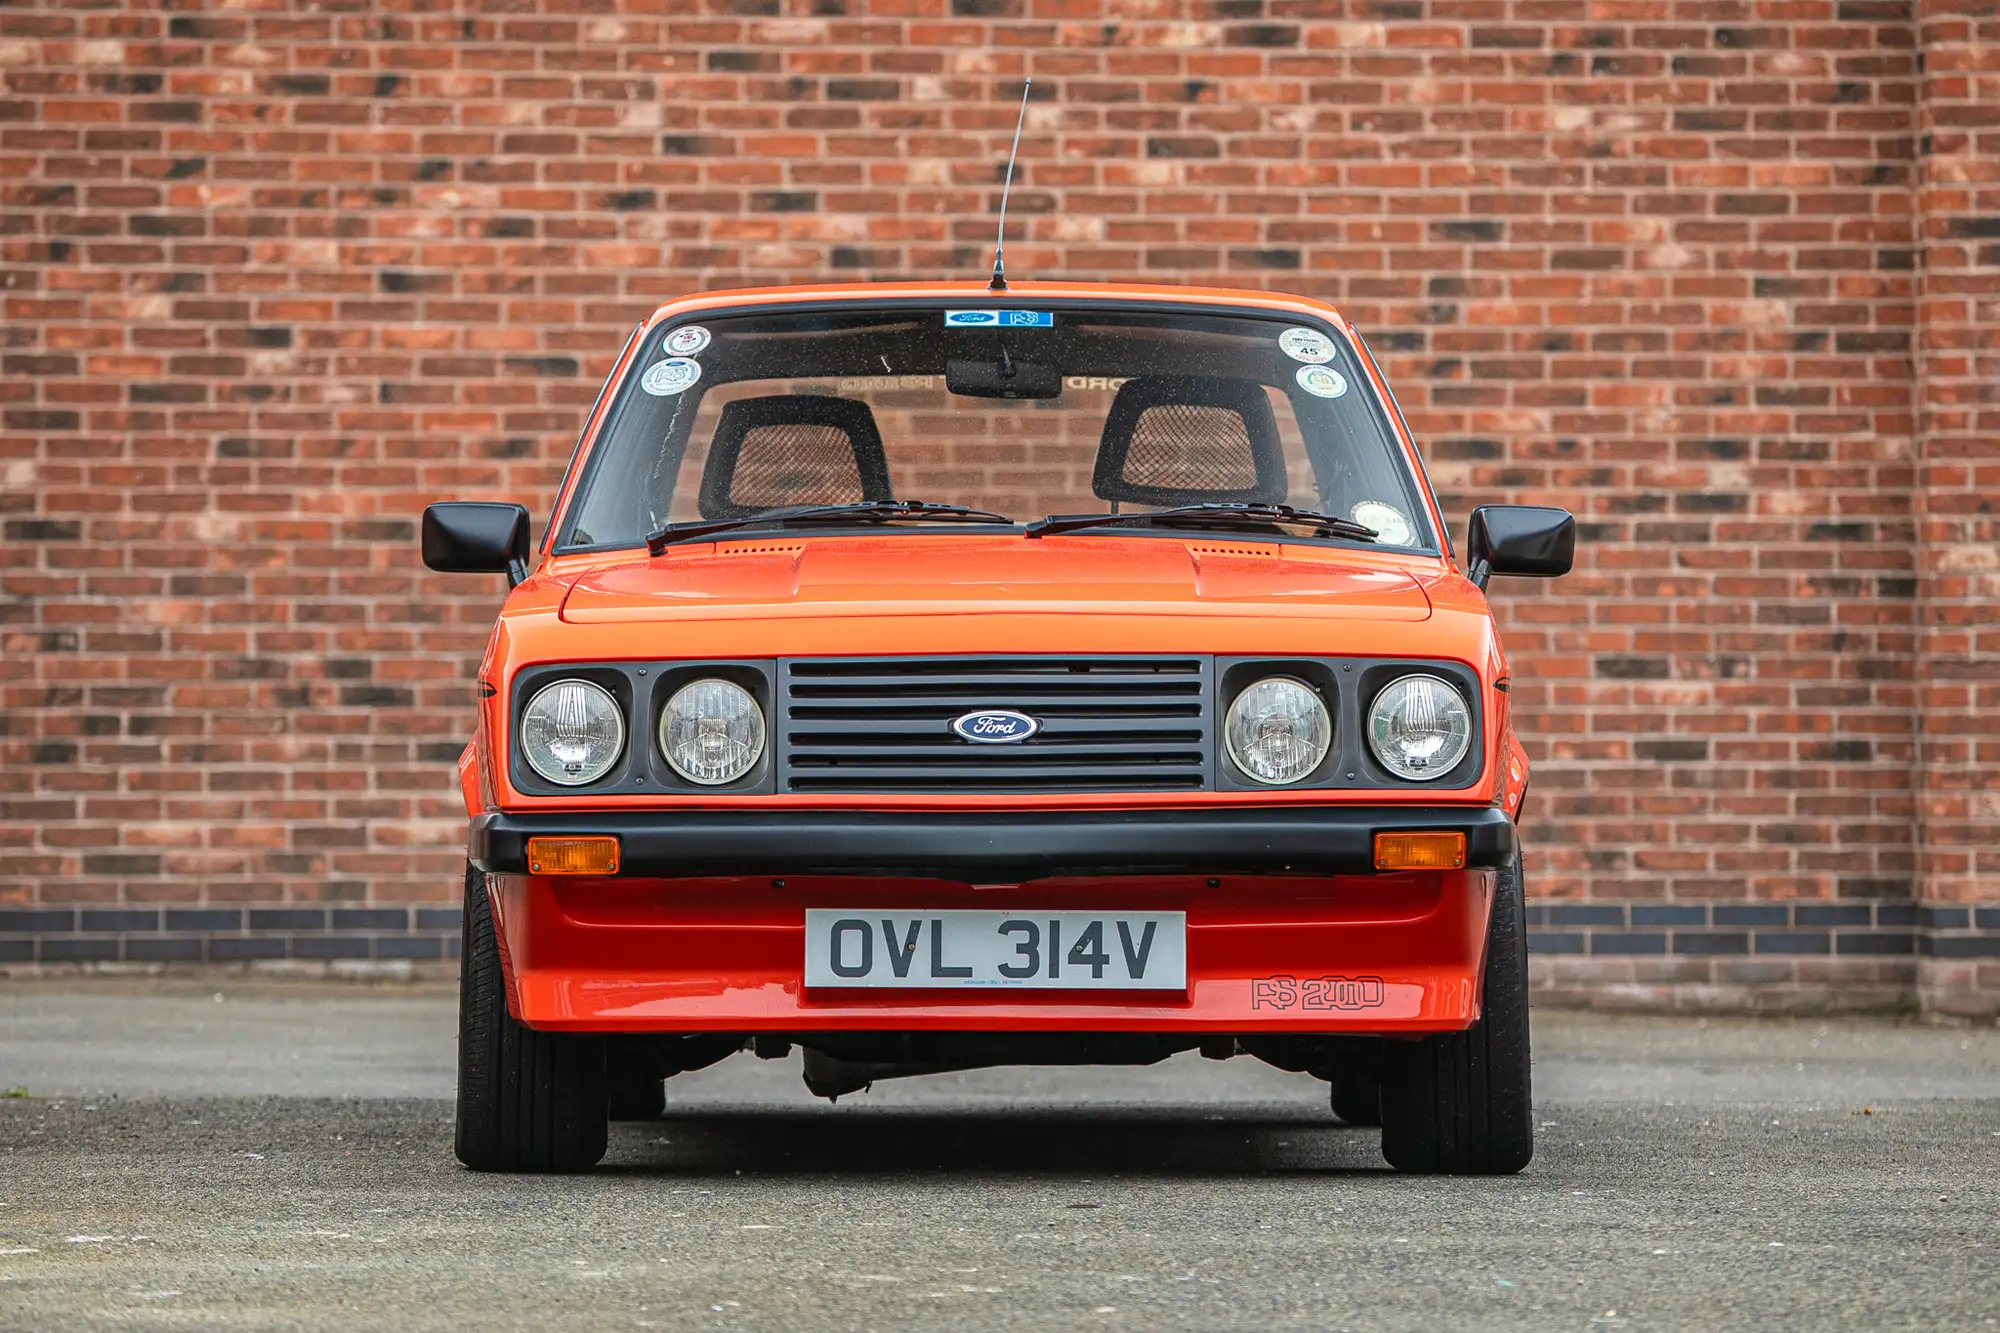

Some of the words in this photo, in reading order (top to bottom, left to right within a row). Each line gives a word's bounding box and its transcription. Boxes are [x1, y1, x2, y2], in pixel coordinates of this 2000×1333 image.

[959, 314, 985, 322] Ford
[1010, 312, 1039, 324] RS
[973, 716, 1017, 734] Ford
[830, 919, 973, 978] OVL
[997, 919, 1158, 979] 314V
[1252, 974, 1297, 1010] RS
[1302, 975, 1385, 1010] 2000
